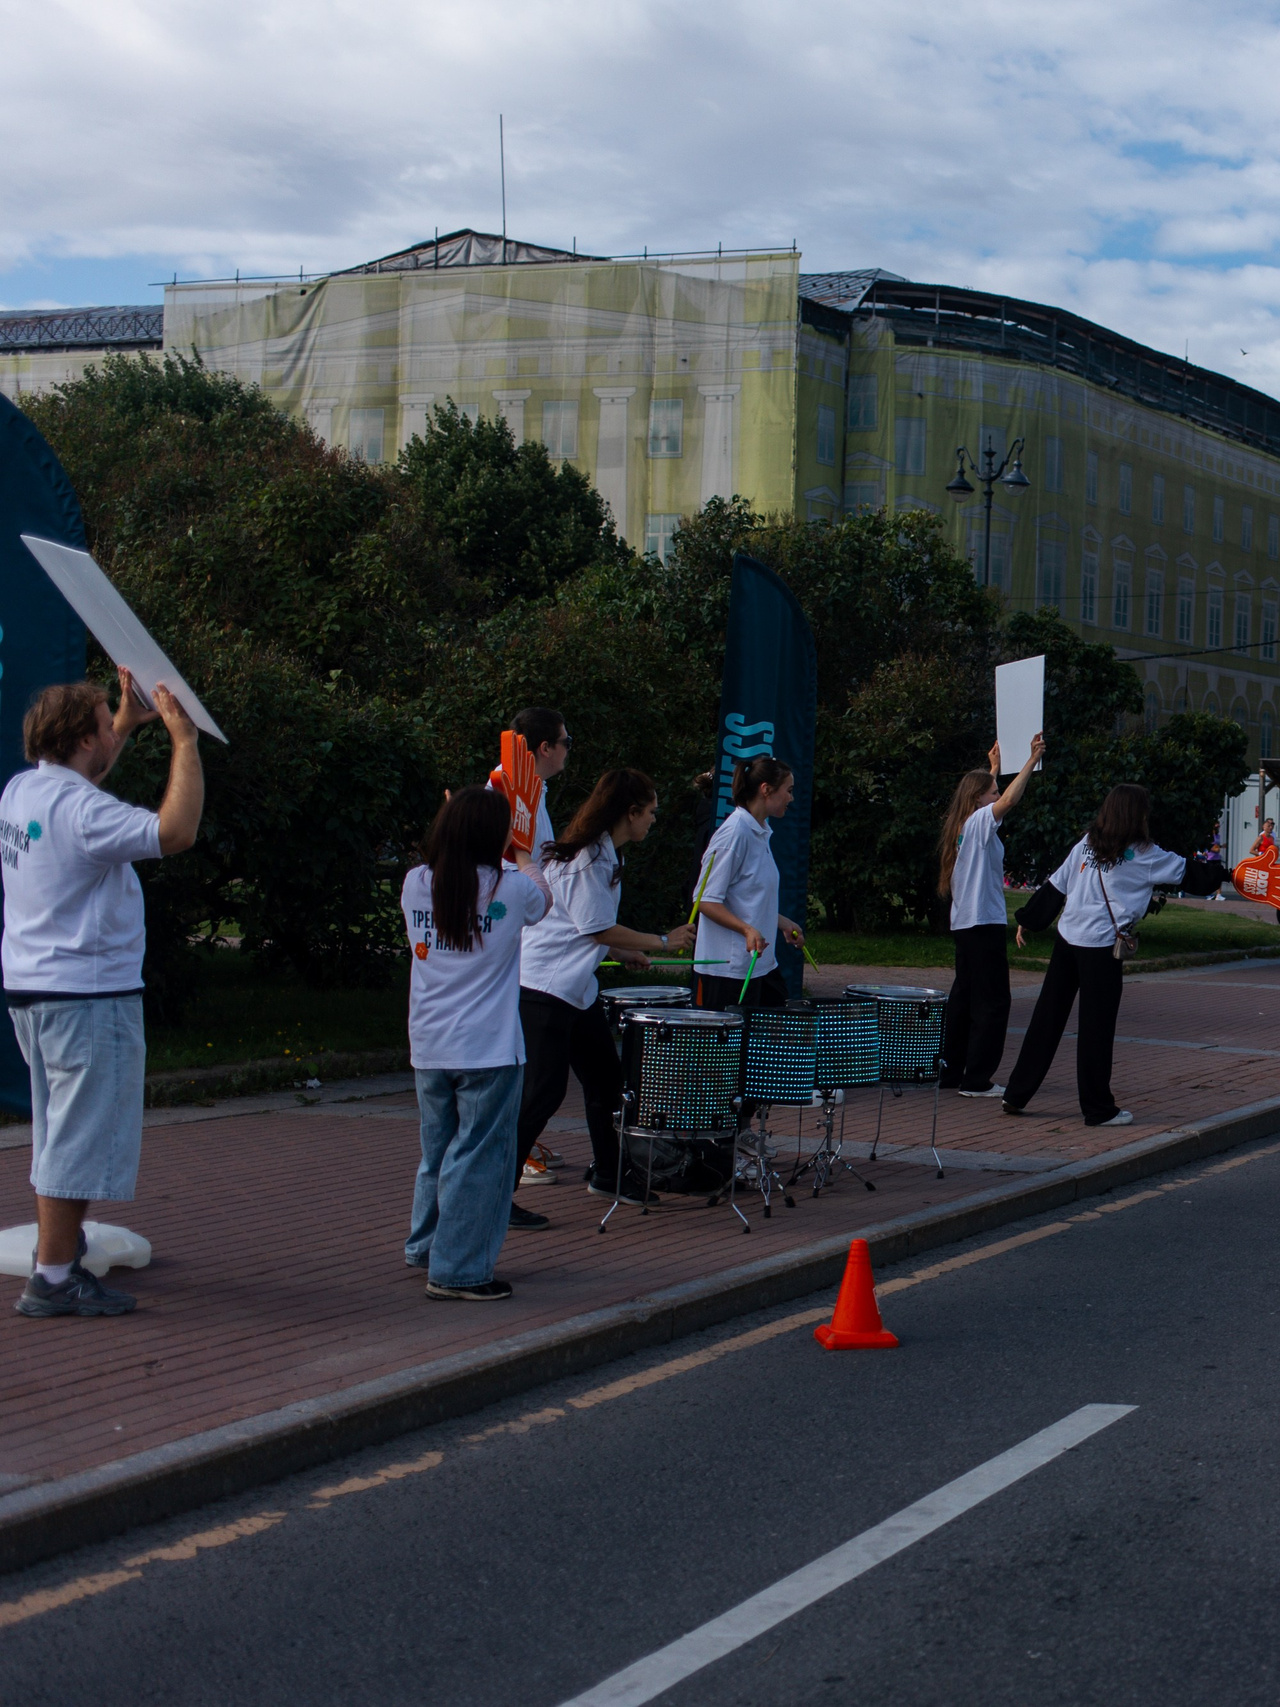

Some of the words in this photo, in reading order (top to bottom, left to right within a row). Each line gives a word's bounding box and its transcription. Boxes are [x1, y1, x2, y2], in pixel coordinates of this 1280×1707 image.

[1243, 867, 1258, 895] FITNESS
[1256, 870, 1269, 897] DDX
[424, 931, 432, 949] С
